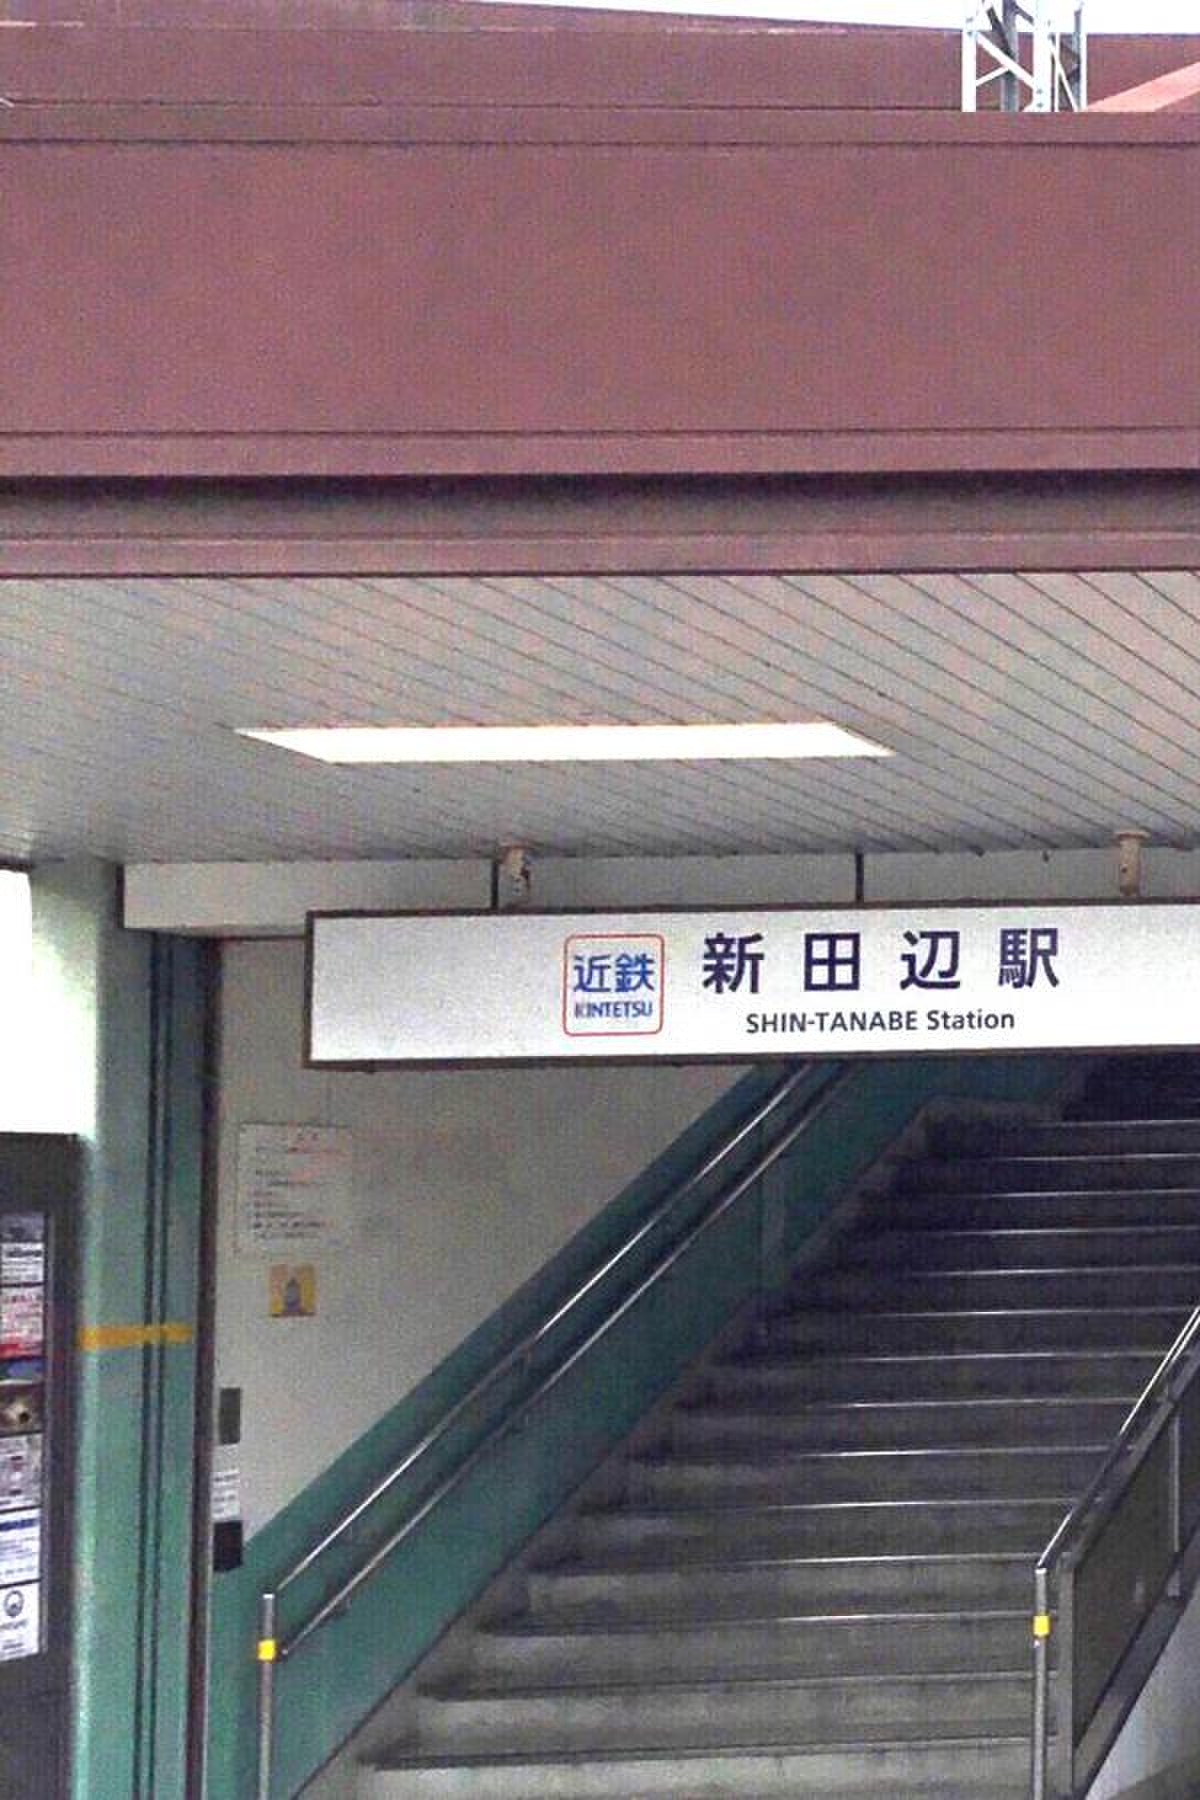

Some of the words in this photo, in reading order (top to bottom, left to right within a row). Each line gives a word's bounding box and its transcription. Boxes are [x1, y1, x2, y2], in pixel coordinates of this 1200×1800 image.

[573, 952, 656, 993] 近鉄
[575, 1000, 653, 1019] KINTETSU
[745, 1010, 918, 1034] SHIN-TANABE
[927, 1008, 1016, 1031] Station
